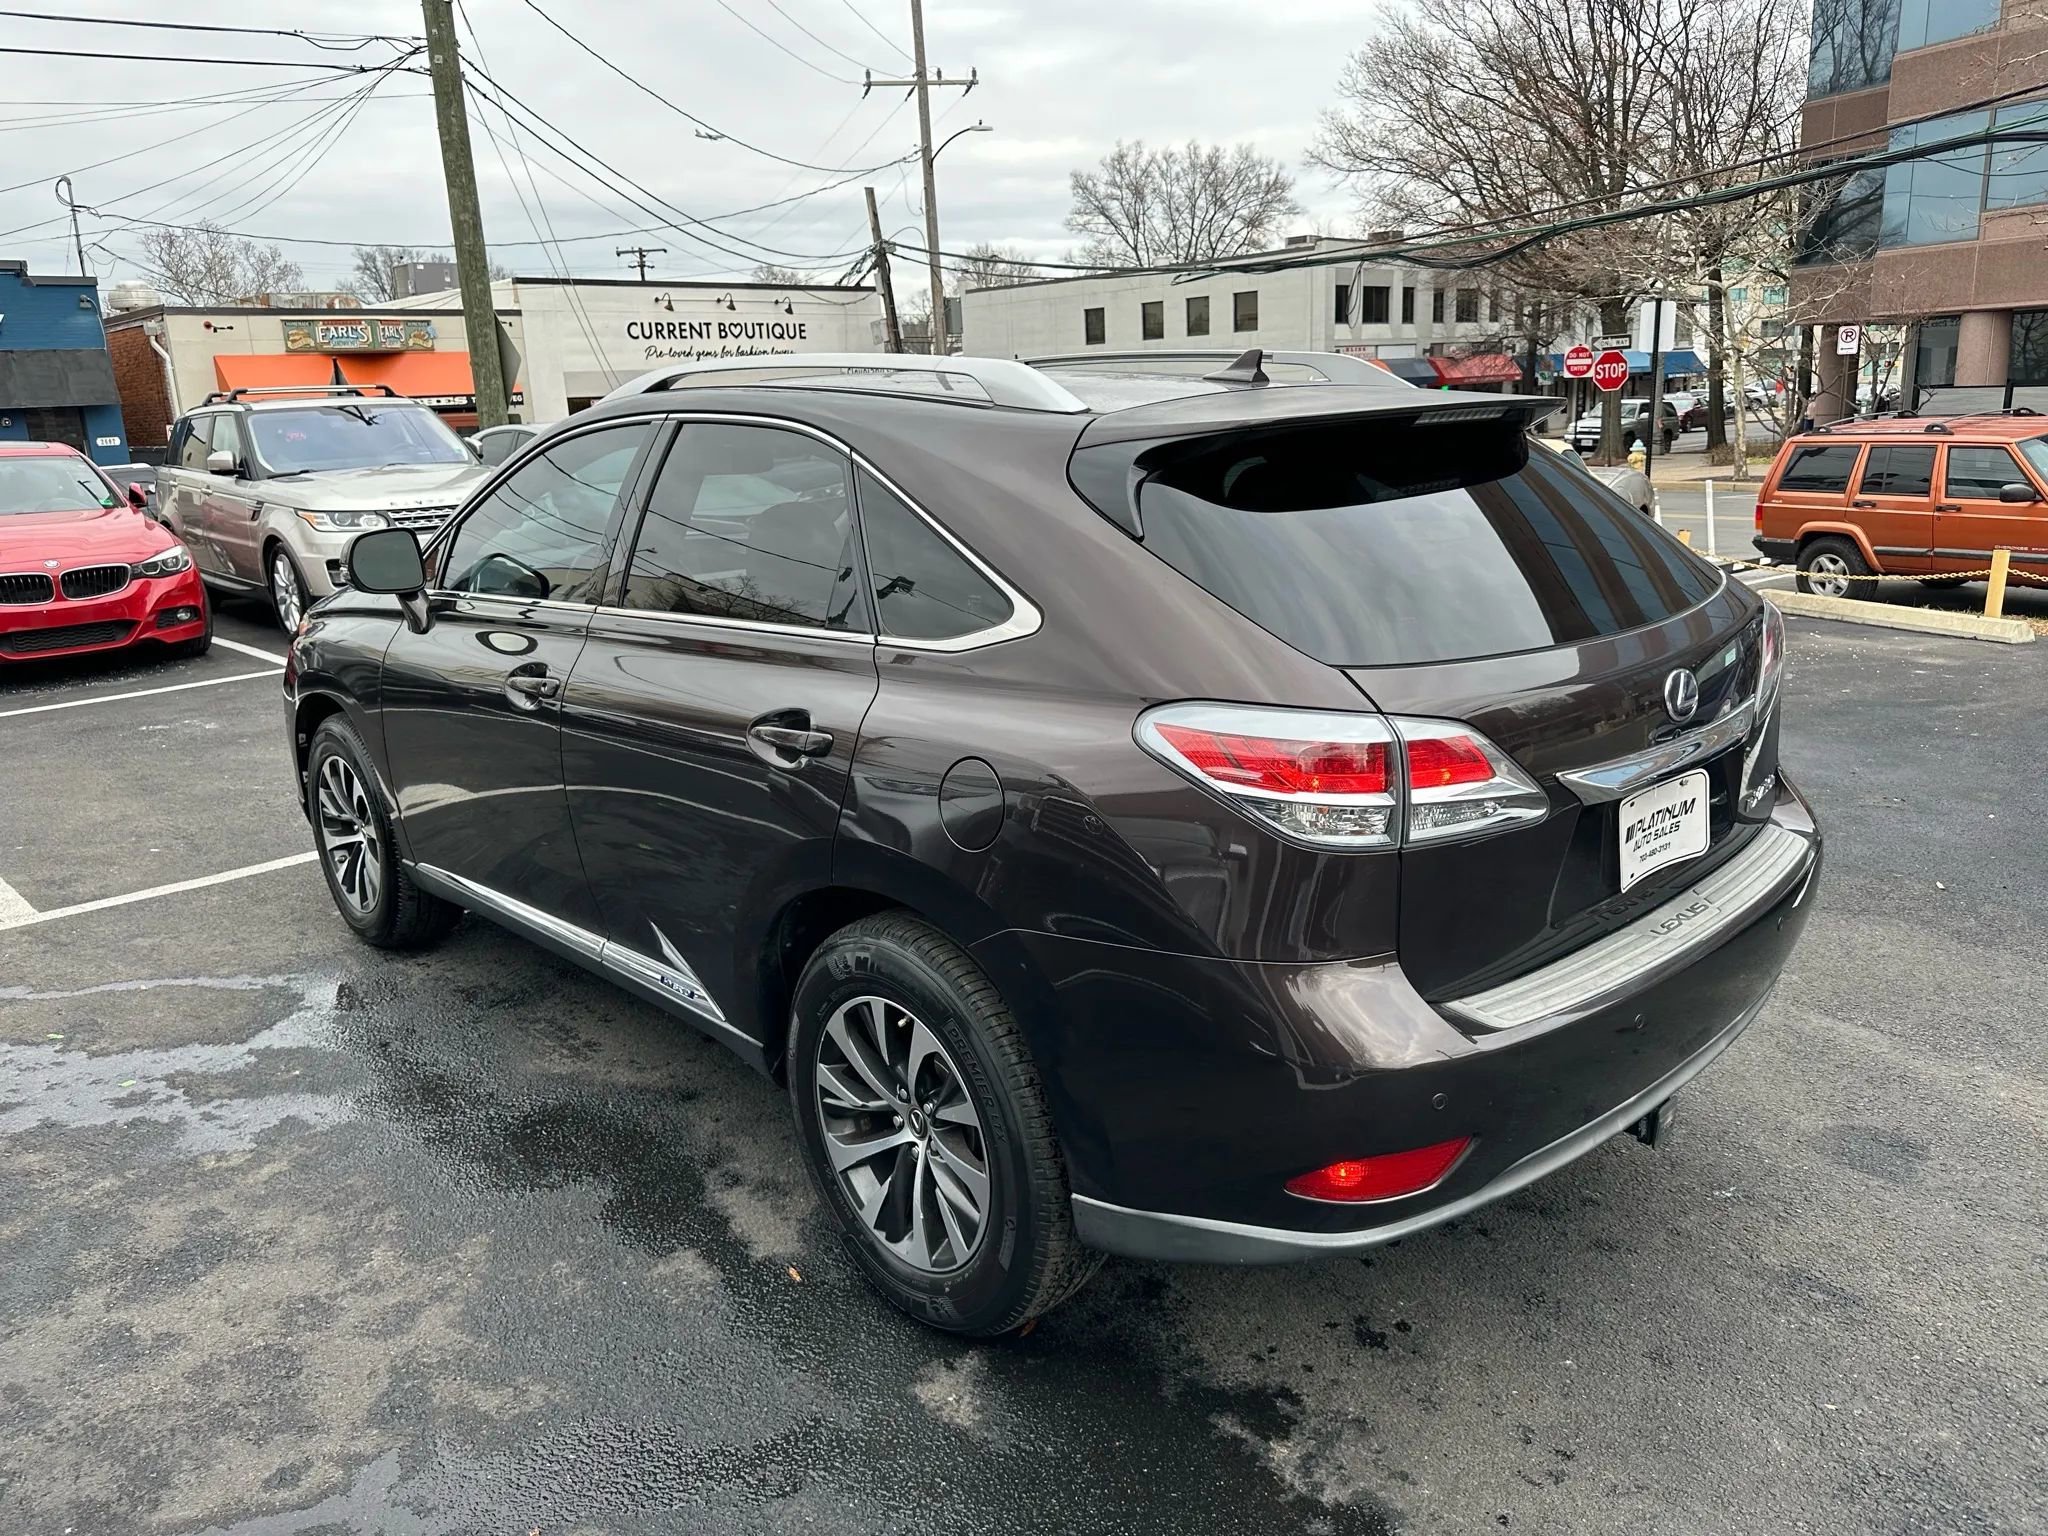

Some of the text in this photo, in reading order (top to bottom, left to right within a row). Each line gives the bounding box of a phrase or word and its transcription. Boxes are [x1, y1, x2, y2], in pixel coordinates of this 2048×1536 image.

[318, 325, 370, 344] EARL'S
[379, 325, 406, 343] EARL'S
[626, 321, 807, 340] CURRENT BOUTIQUE
[644, 345, 694, 361] Pre-loved
[695, 350, 719, 361] gems
[720, 345, 734, 358] for
[735, 345, 770, 358] fashion
[1595, 362, 1627, 380] STOP
[1634, 797, 1697, 838] PLATINUM
[1633, 820, 1681, 853] AUTO SALES
[1650, 902, 1710, 936] LEXUS
[948, 1026, 995, 1109] PREMIER
